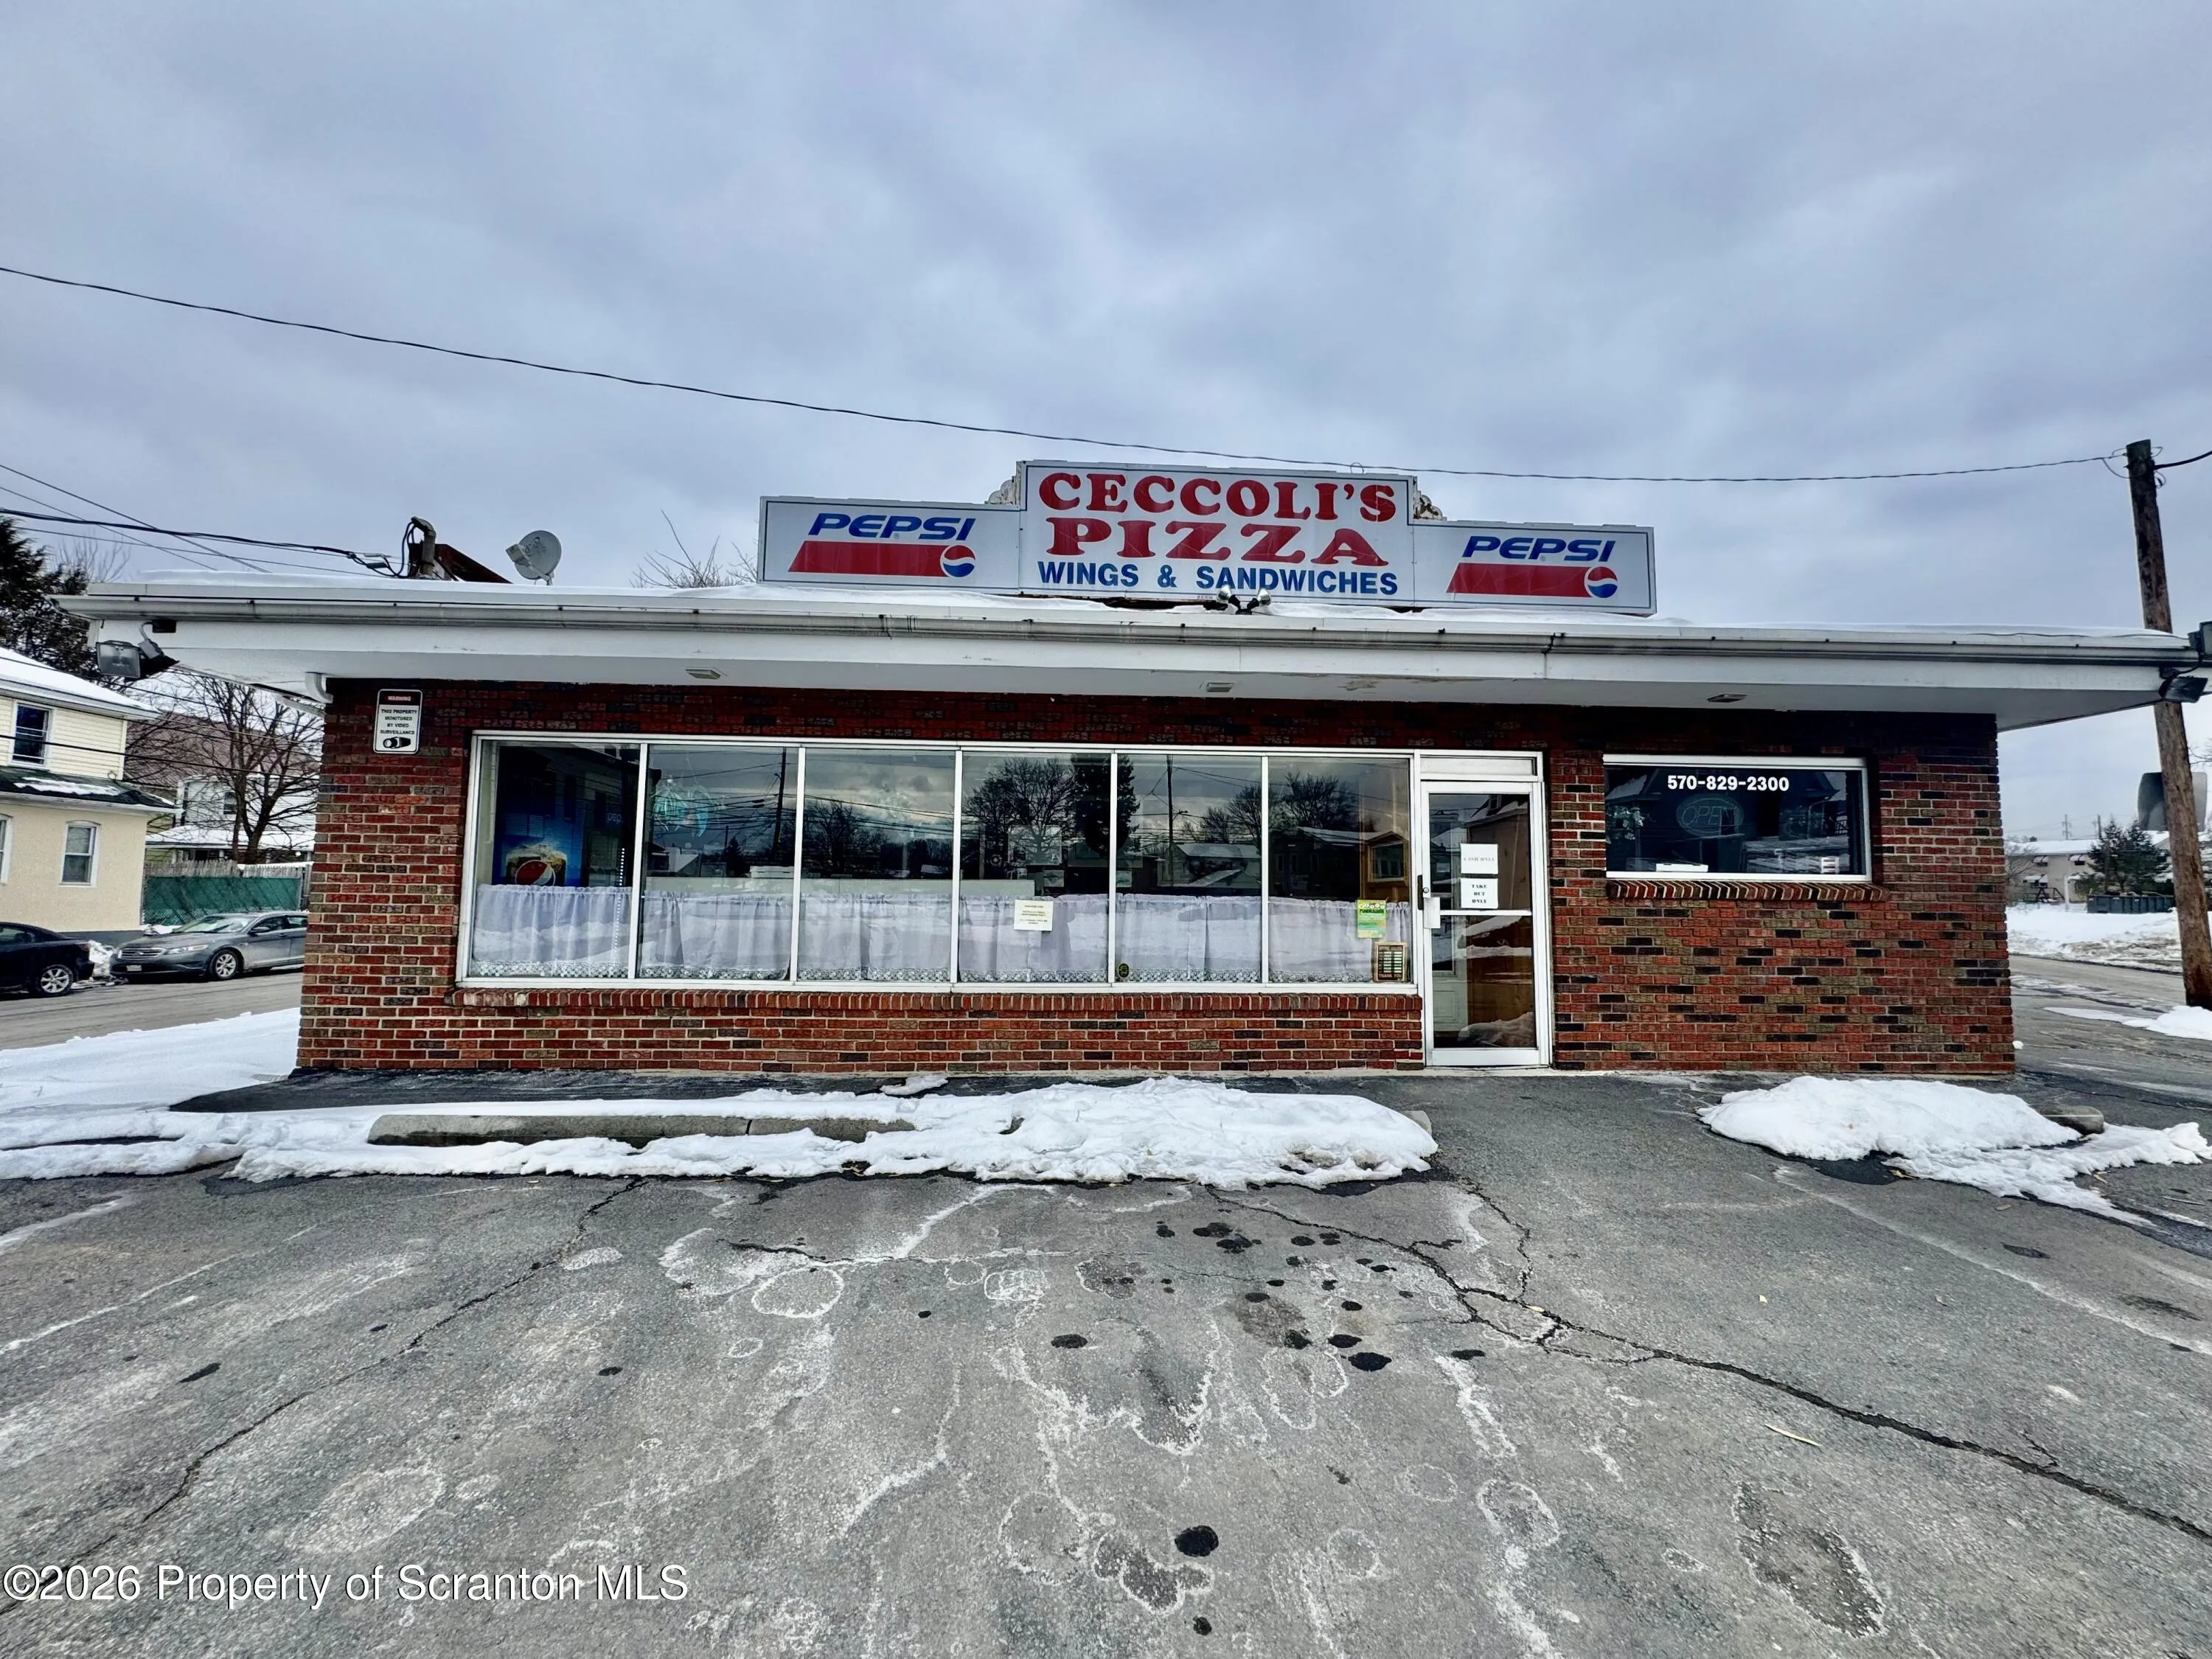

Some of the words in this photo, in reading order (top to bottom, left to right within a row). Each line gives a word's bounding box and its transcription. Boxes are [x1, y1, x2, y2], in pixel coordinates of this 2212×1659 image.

[1039, 472, 1397, 523] CECCOLI'S
[807, 512, 976, 541] PEPSI
[1045, 516, 1389, 567] PIZZA
[1461, 535, 1616, 562] PEPSI
[1037, 561, 1139, 588] WINGS
[1157, 565, 1177, 588] &
[1196, 565, 1398, 596] SANDWICHES
[1667, 775, 1790, 791] 570-829-2300
